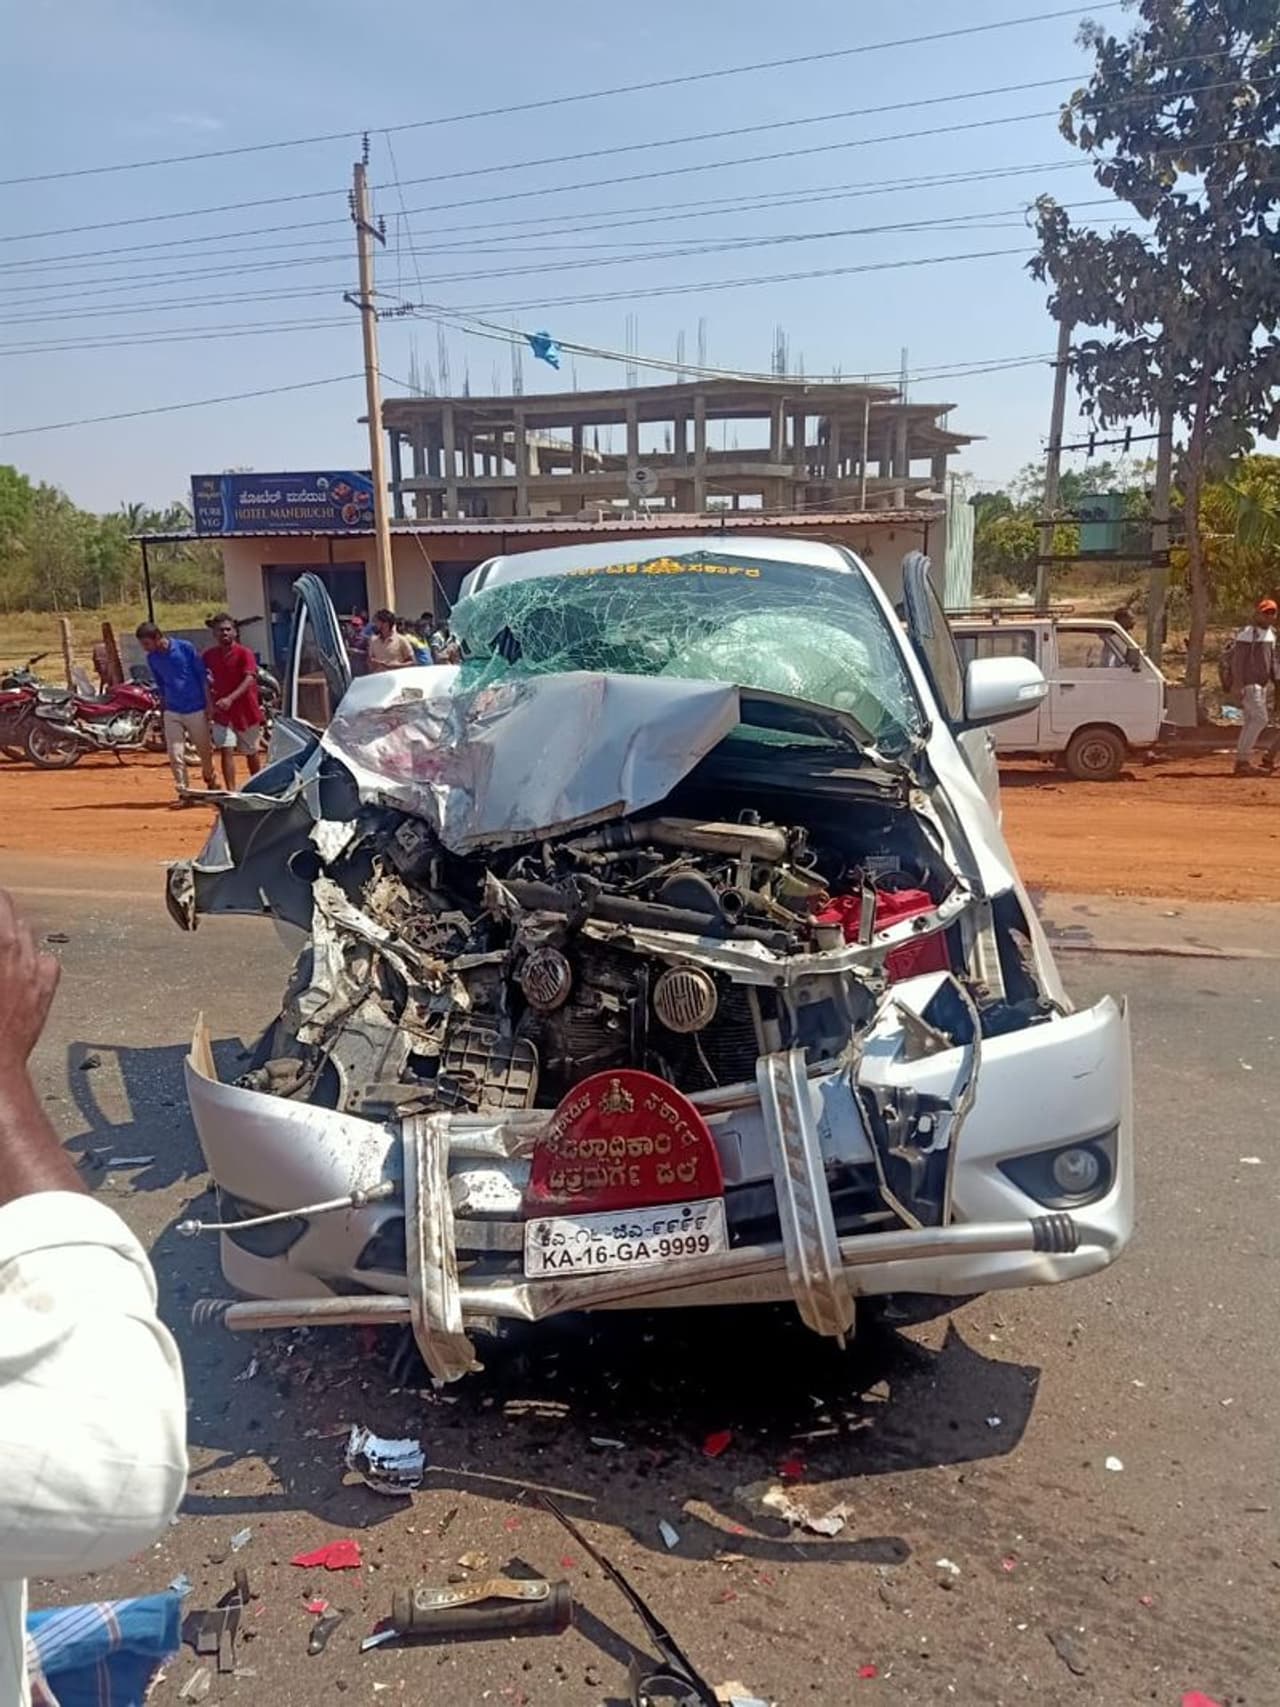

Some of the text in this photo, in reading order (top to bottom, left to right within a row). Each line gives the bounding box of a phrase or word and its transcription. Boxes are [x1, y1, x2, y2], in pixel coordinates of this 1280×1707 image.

[235, 506, 335, 520] HOTEL MANERUCHI
[201, 518, 220, 529] VEG
[542, 1234, 711, 1270] KA-16-GA-9999
